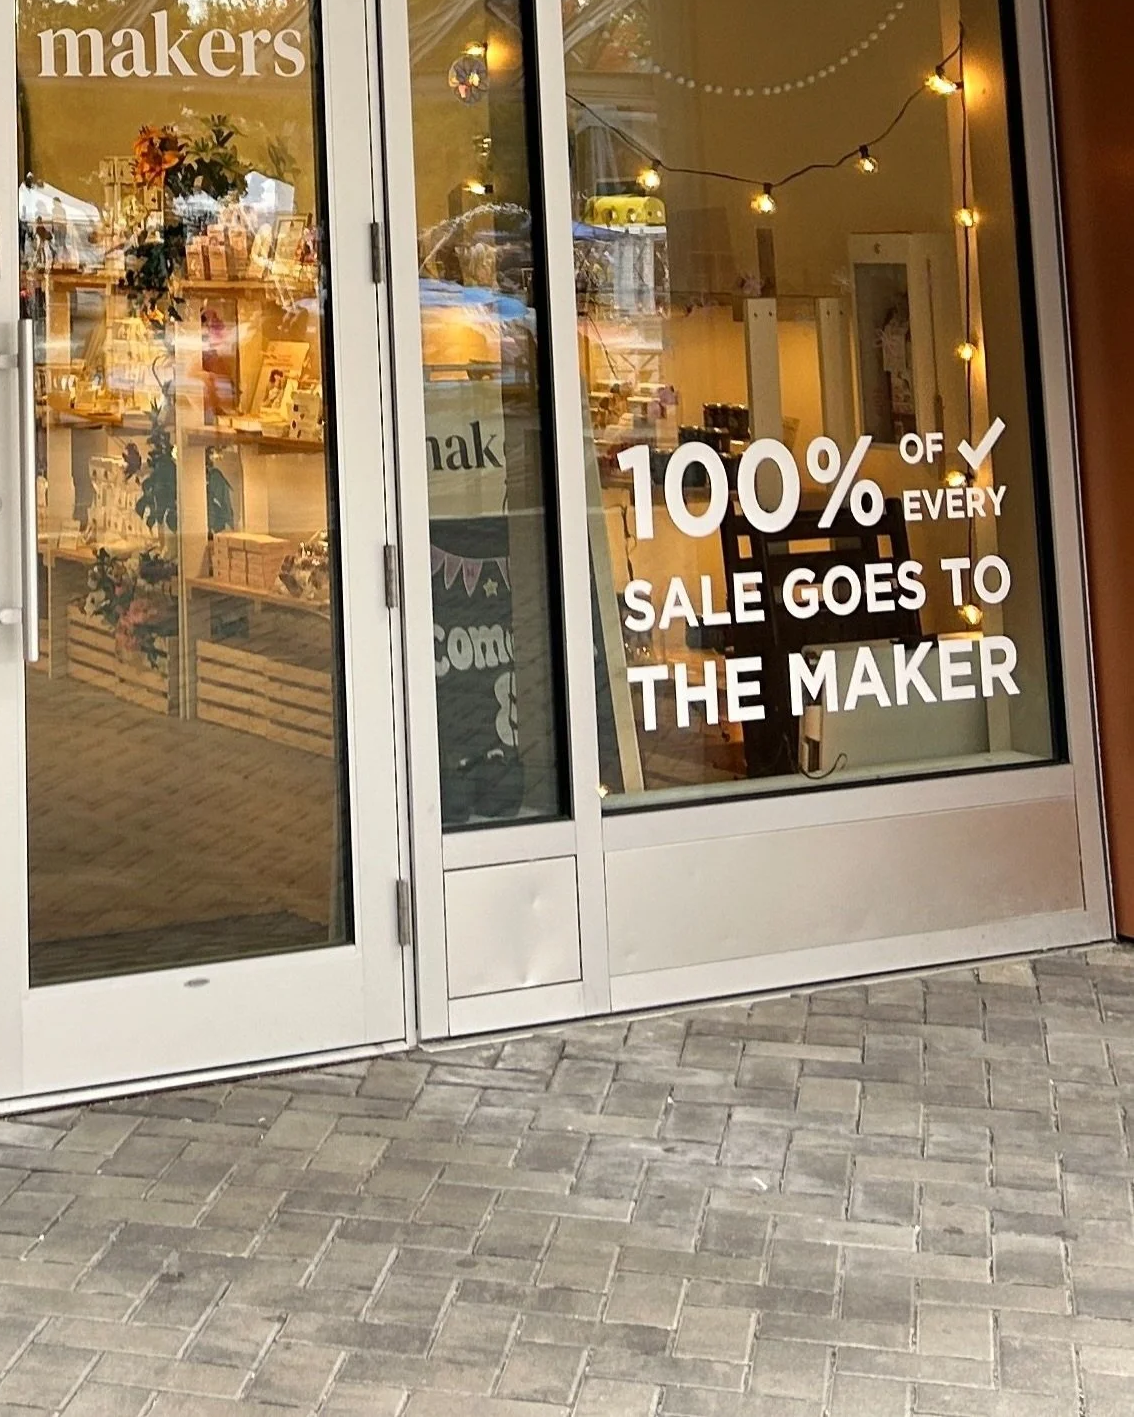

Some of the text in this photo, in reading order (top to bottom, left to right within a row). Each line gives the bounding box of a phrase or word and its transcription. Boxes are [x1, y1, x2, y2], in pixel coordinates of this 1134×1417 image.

[37, 9, 306, 79] makers
[617, 432, 944, 540] 100% OF
[902, 485, 1008, 522] EVERY
[623, 554, 1012, 632] SALE GOES TO
[626, 638, 1020, 731] THE MAKER
